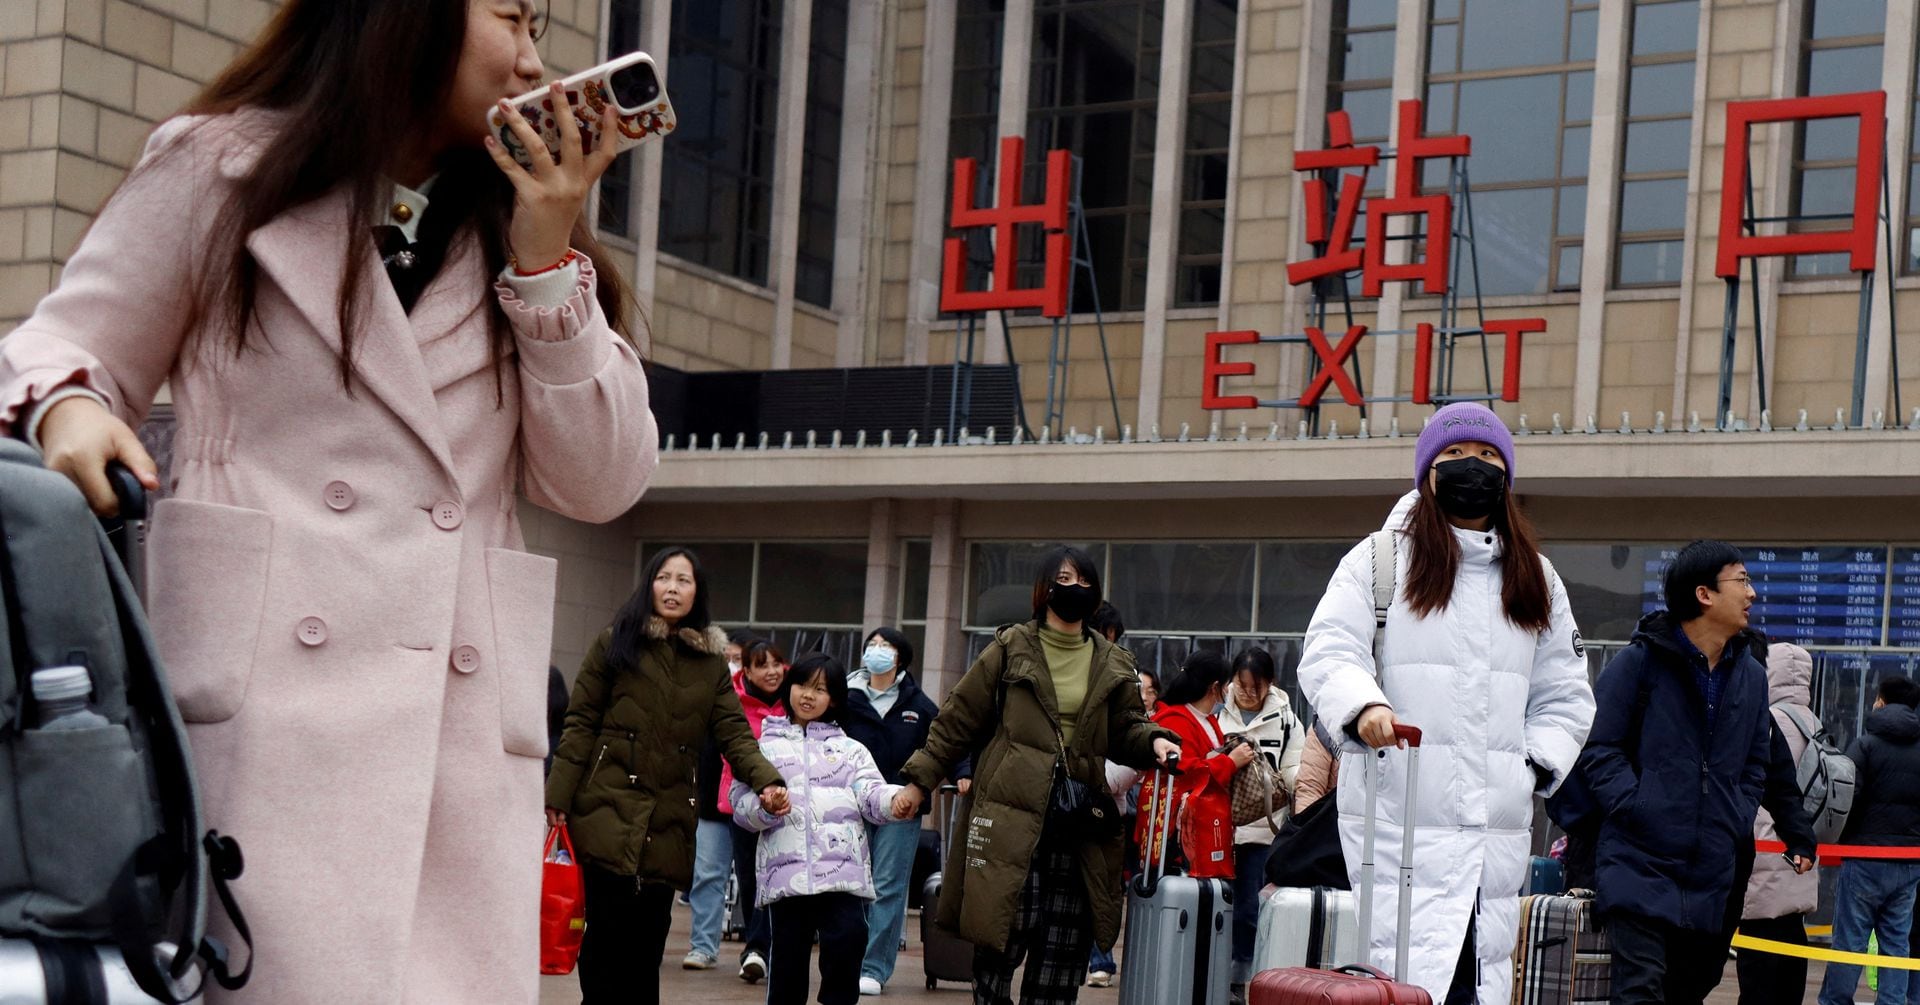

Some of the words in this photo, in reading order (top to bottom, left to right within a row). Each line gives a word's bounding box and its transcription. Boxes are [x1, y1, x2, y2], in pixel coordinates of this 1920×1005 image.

[941, 90, 1886, 317] 出站口
[1202, 319, 1546, 409] EXIT
